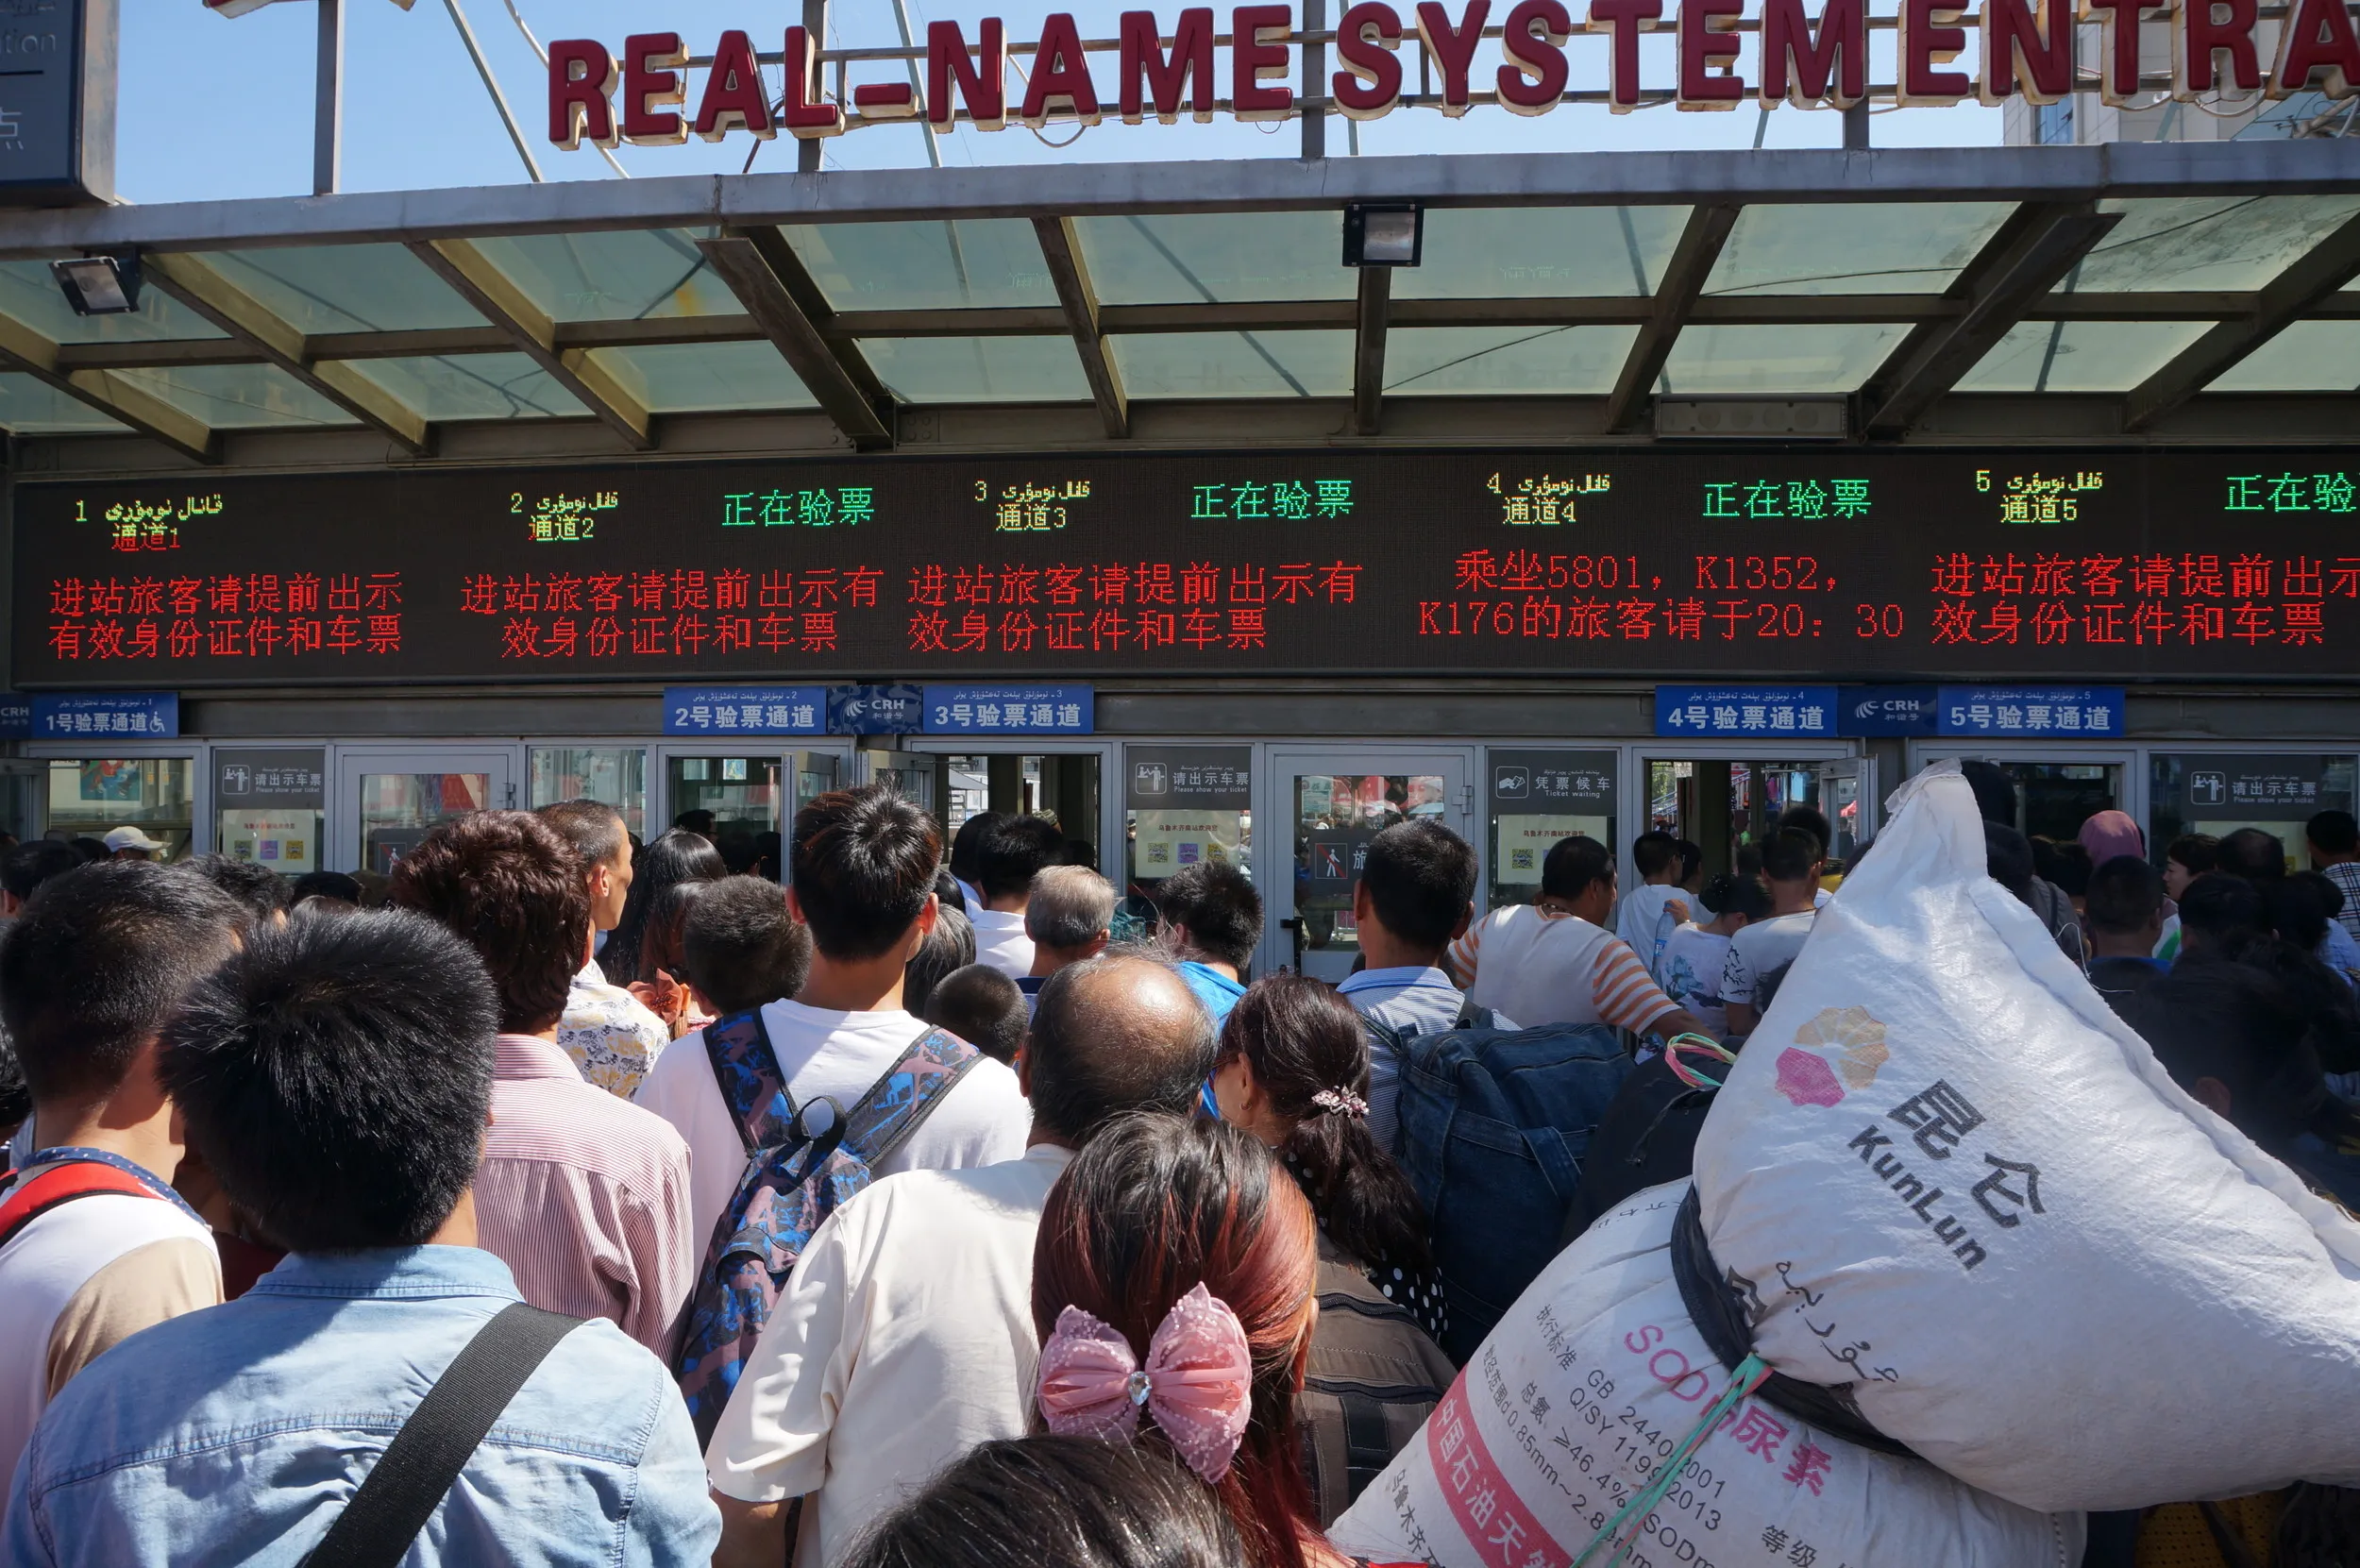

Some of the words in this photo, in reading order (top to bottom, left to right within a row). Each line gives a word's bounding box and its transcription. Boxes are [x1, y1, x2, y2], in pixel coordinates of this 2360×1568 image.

[548, 5, 1292, 150] REAL-NAME
[1332, 0, 1869, 121] SYSTEM
[974, 480, 987, 502] 3
[1486, 472, 1502, 495] 4
[1976, 469, 1991, 493] 5
[76, 499, 88, 522] 1
[511, 492, 523, 514] 2
[721, 487, 875, 527] 正在验票
[1190, 480, 1355, 520] 正在验票
[1502, 496, 1576, 526] 通道4
[1702, 479, 1873, 519] 正在验票
[1999, 494, 2078, 524] 通道5
[528, 513, 594, 542] 通道2
[995, 503, 1066, 531] 通道3
[110, 521, 180, 552] 通道1
[50, 571, 402, 618] 进站旅客请提前出示
[461, 565, 885, 615] 进站旅客请提前出示有
[907, 561, 1363, 610] 进站旅客请提前出示有
[49, 613, 401, 659] 有效身份证件和车票
[502, 612, 838, 658] 效身份证件和车票
[907, 607, 1267, 651] 效身份证件和车票
[1930, 599, 2325, 646] 效身份证件和车票
[675, 704, 815, 729] 2号验票通道
[871, 700, 904, 710] CRH
[935, 703, 1081, 727] 3号验票通道
[1668, 705, 1824, 731] 4号验票通道
[1883, 700, 1919, 711] CRH
[1951, 704, 2111, 731] 5号验票通道
[47, 712, 147, 733] 1号验票通道
[255, 773, 322, 786] 请出示车票
[1172, 771, 1249, 785] 请出示车票
[1535, 776, 1610, 791] 凭票候车
[2232, 781, 2317, 796] 请出示车票
[1886, 1077, 2048, 1228] 昆仑
[1846, 1123, 1987, 1271] KunLun
[1536, 1304, 1577, 1371] 执行标准
[1586, 1369, 1616, 1400] GB
[1569, 1387, 1615, 1436] Q/SY
[1761, 1524, 1817, 1568] 等级
